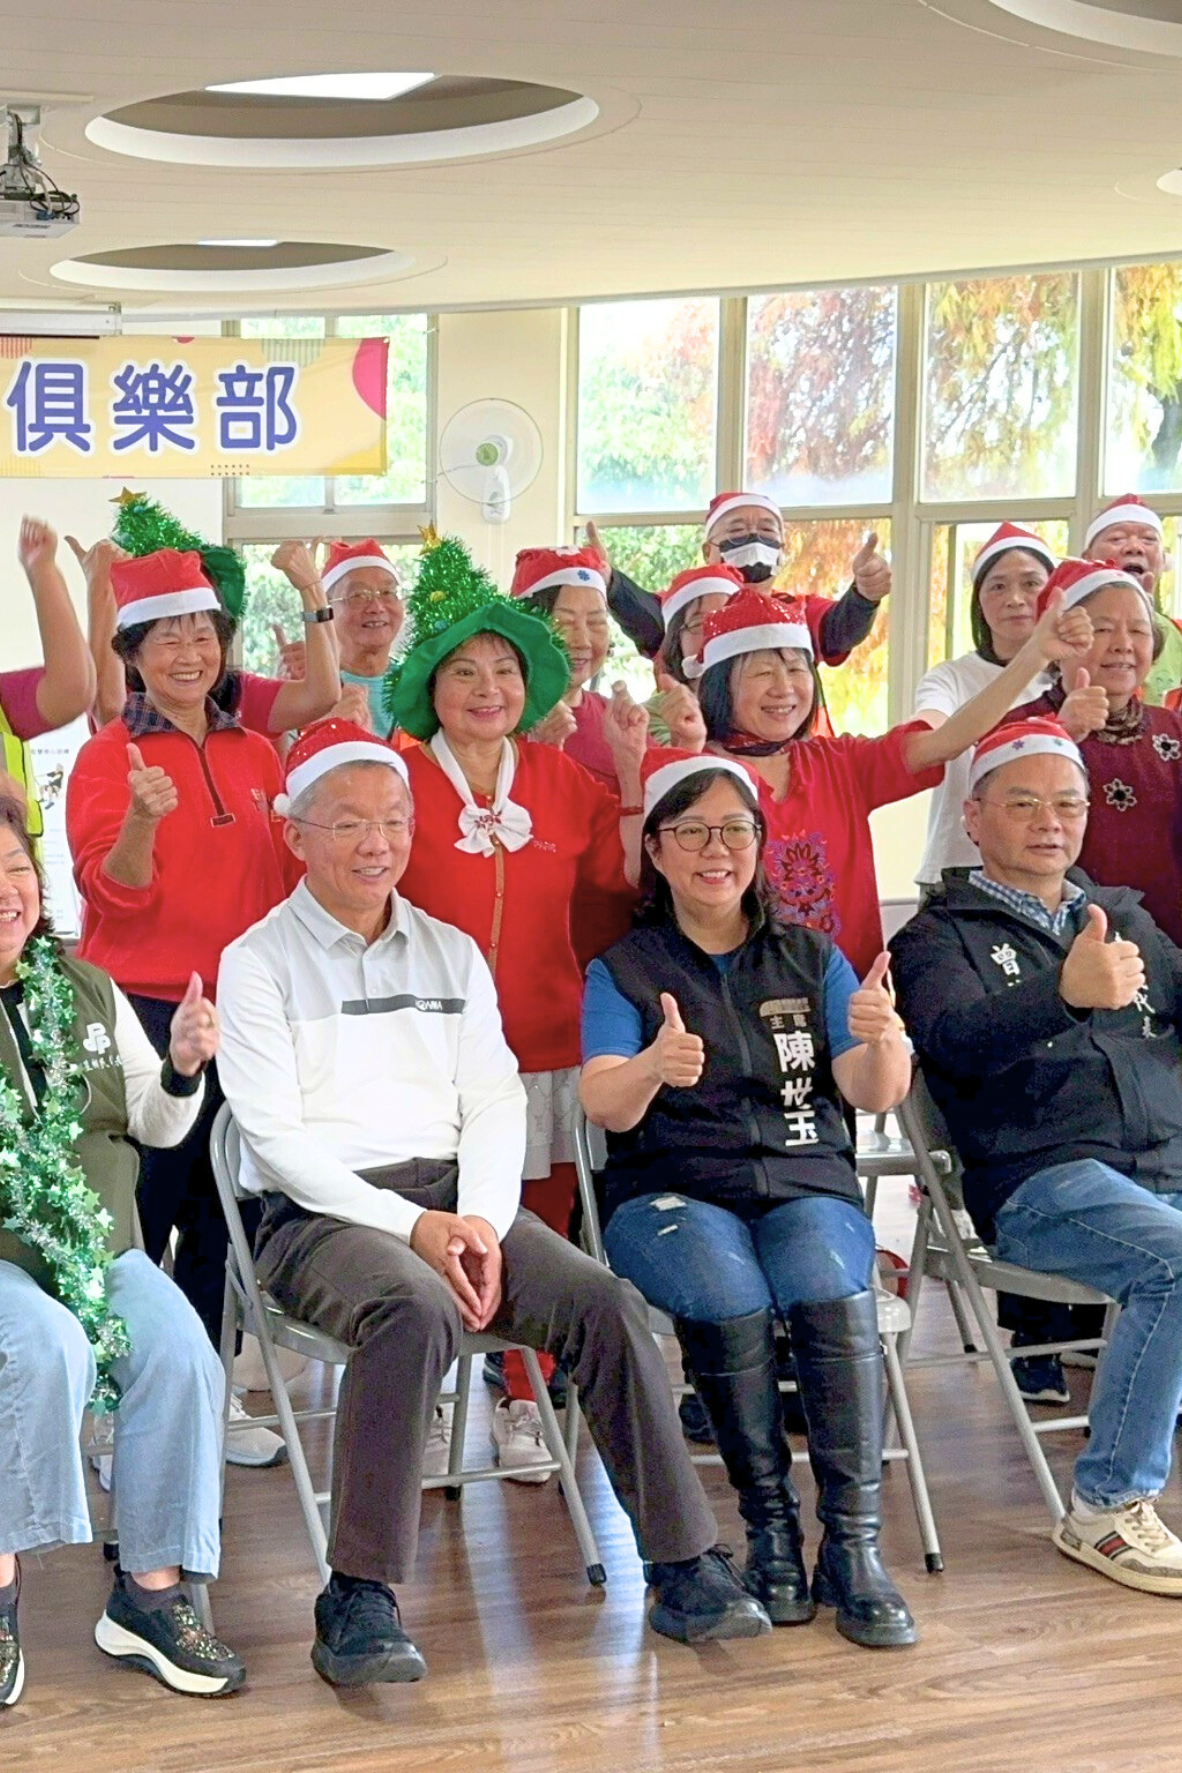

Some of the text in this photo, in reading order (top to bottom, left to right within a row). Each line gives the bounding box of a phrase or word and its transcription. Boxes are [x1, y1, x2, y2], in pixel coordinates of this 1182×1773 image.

[990, 942, 1021, 987] 曾
[772, 1030, 820, 1147] 陳世玉
